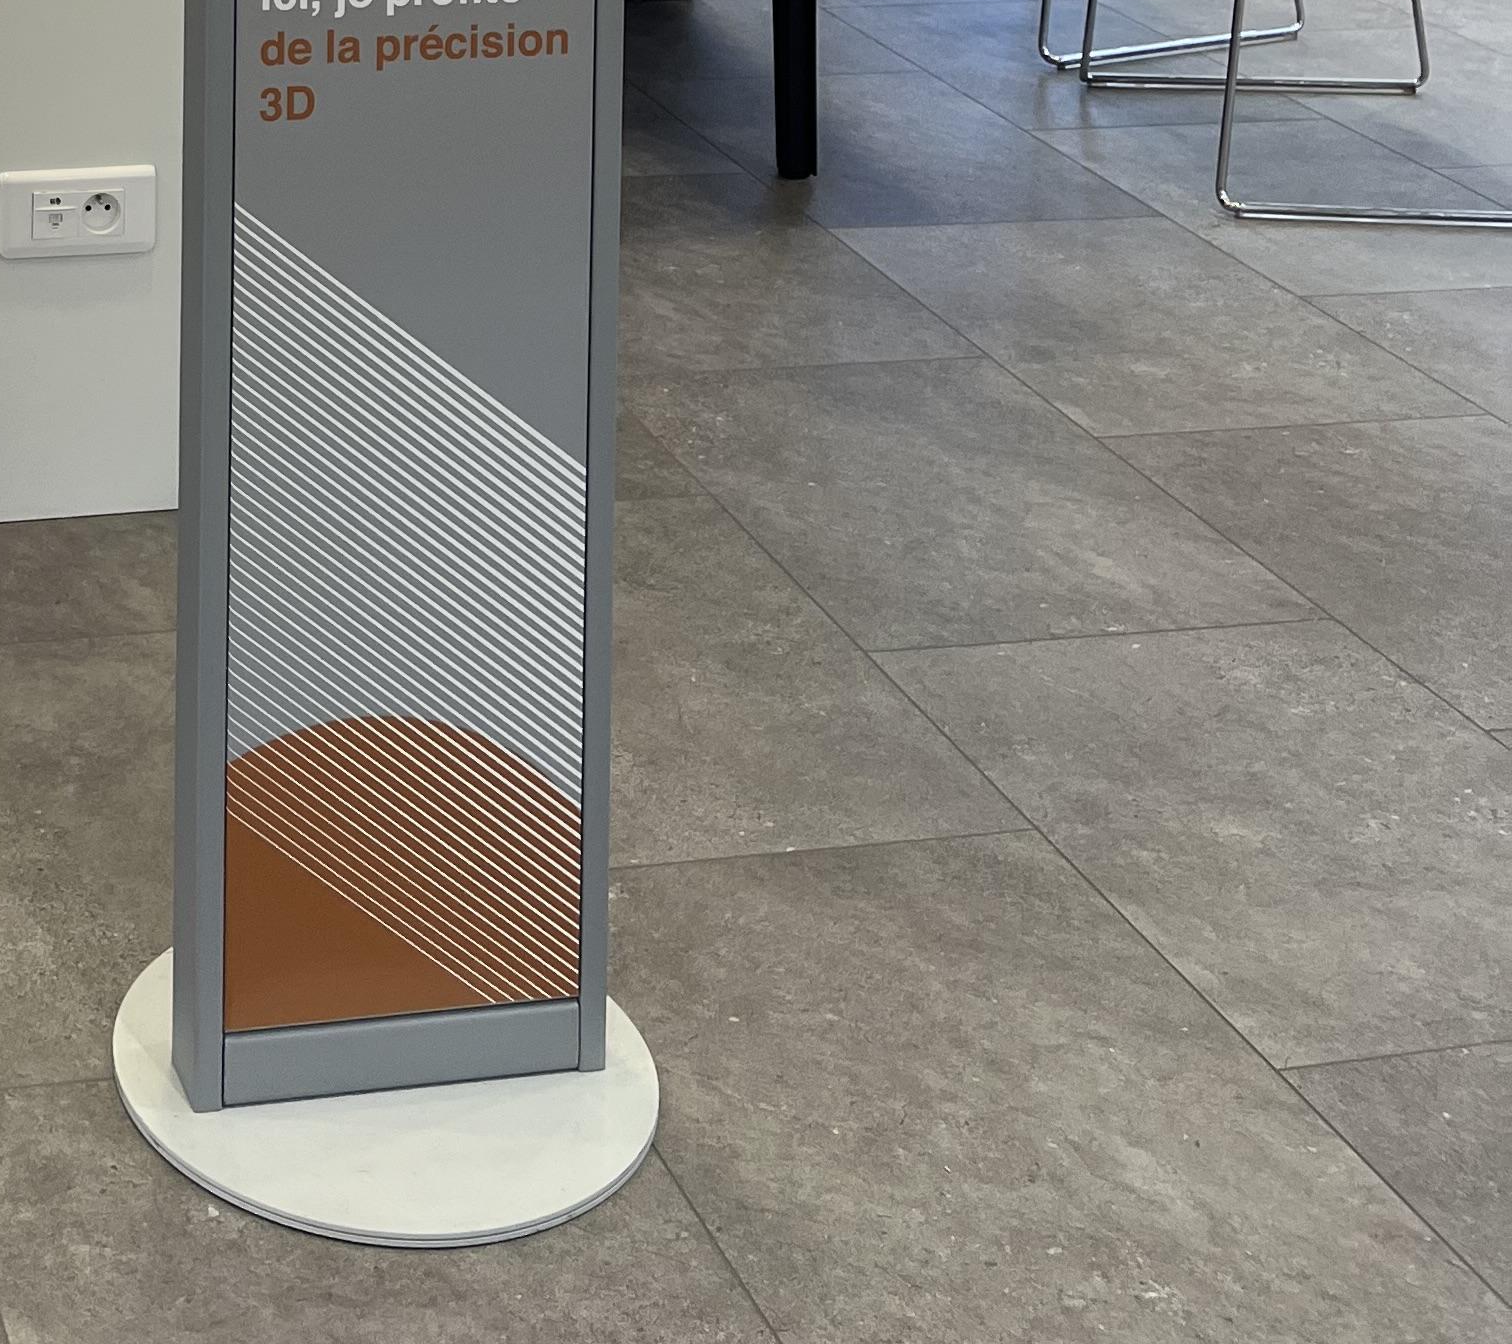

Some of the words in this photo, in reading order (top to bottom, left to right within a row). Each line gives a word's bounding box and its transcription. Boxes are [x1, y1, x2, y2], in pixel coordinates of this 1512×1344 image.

[260, 31, 313, 66] de
[327, 30, 361, 65] la
[375, 23, 570, 71] précision
[260, 84, 316, 123] 3D
